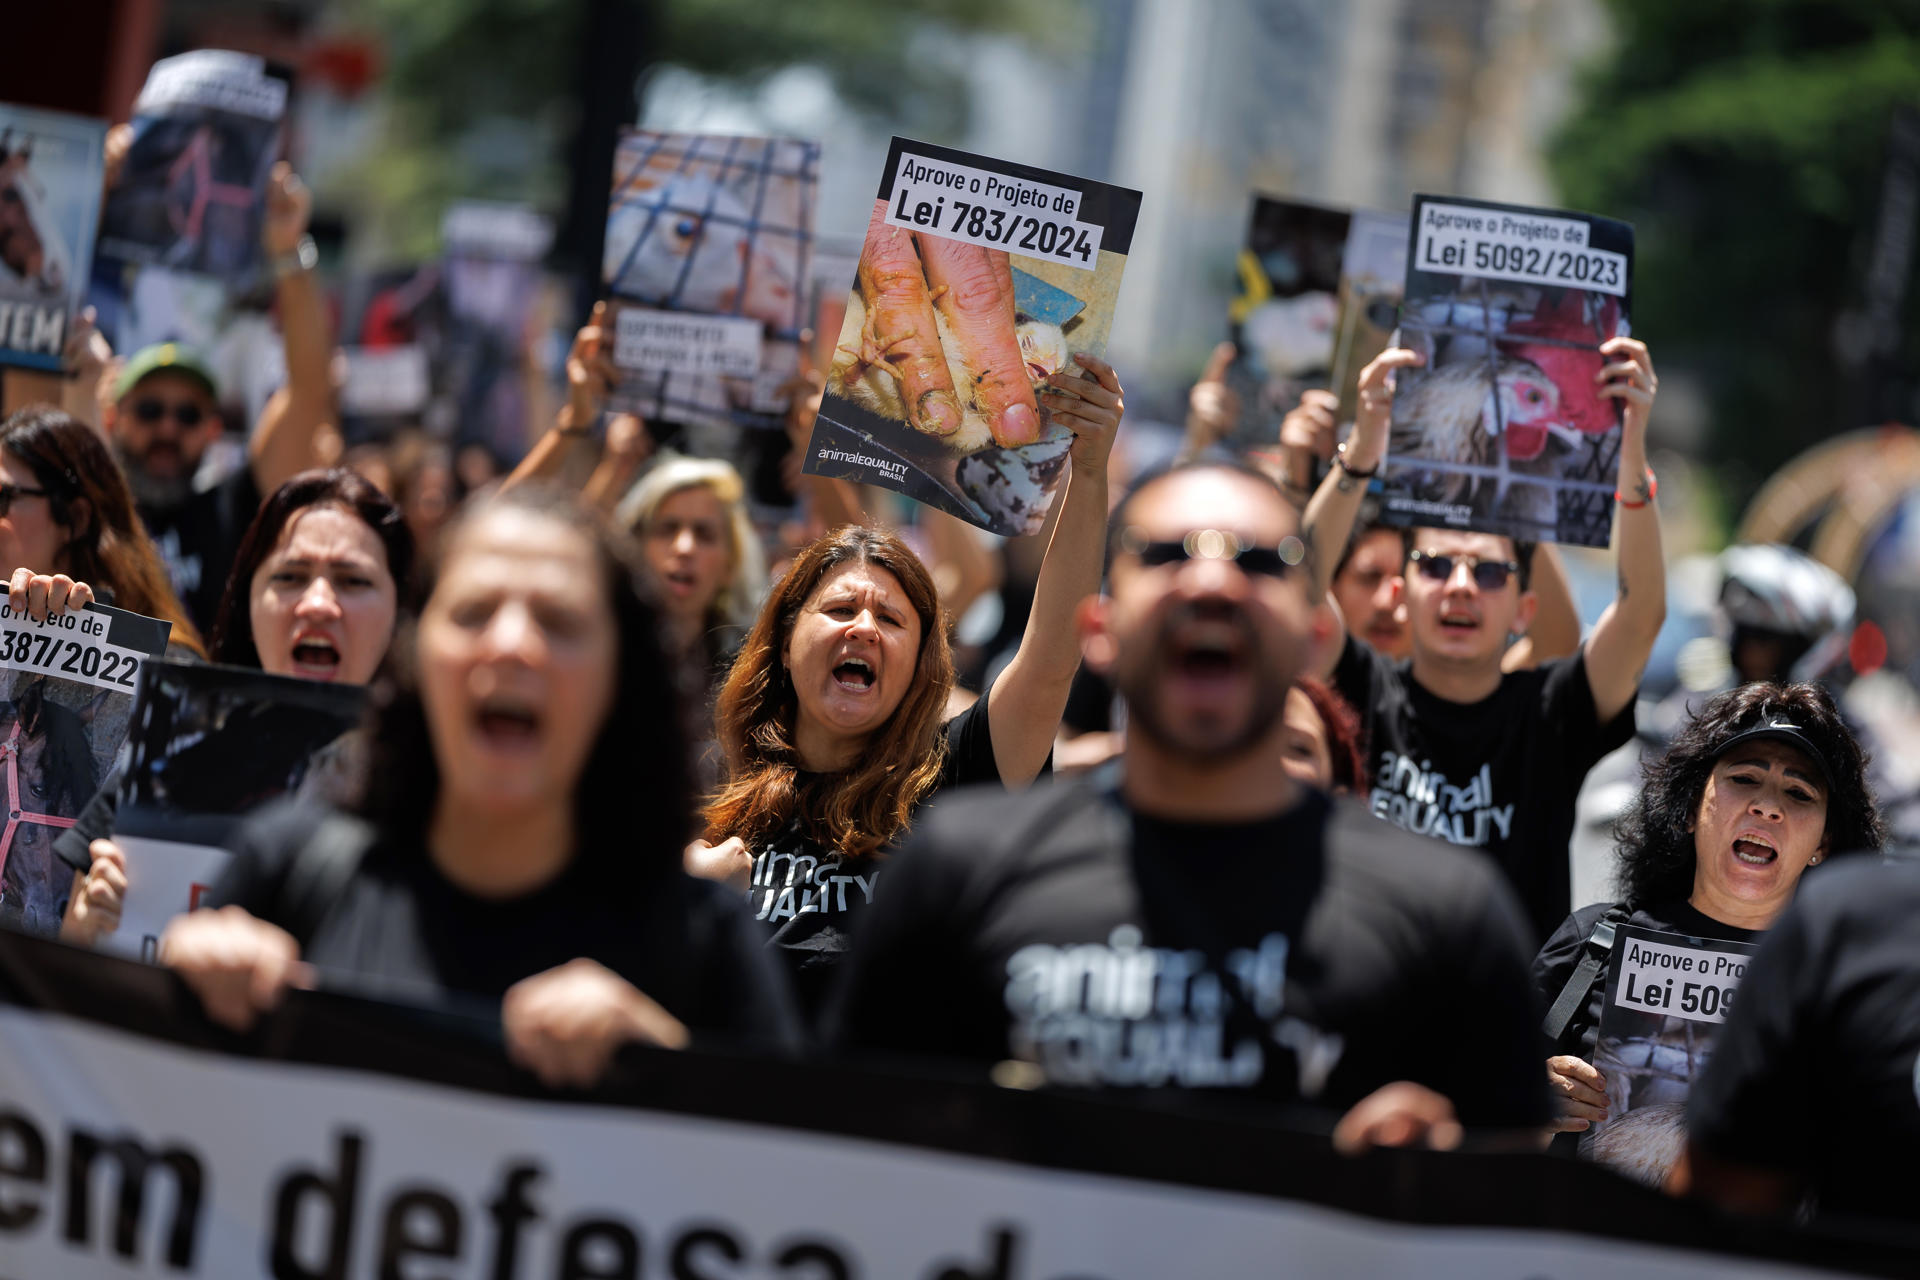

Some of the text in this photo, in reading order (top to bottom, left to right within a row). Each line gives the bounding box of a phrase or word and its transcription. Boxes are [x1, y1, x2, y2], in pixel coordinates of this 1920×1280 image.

[902, 159, 1075, 214] Aprove o Projeto de
[895, 189, 1091, 262] Lei 783/2024
[1426, 209, 1583, 243] Aprove o Projeto de
[1426, 237, 1619, 286] Lei 5092/2023
[818, 448, 908, 475] animalEQUALITY
[879, 469, 905, 483] BRASIL
[1, 604, 12, 619] o
[81, 616, 104, 637] de
[746, 871, 880, 923] UALITY
[1628, 944, 1746, 978] Aprove o Pro
[1625, 973, 1736, 1018] Lei 509
